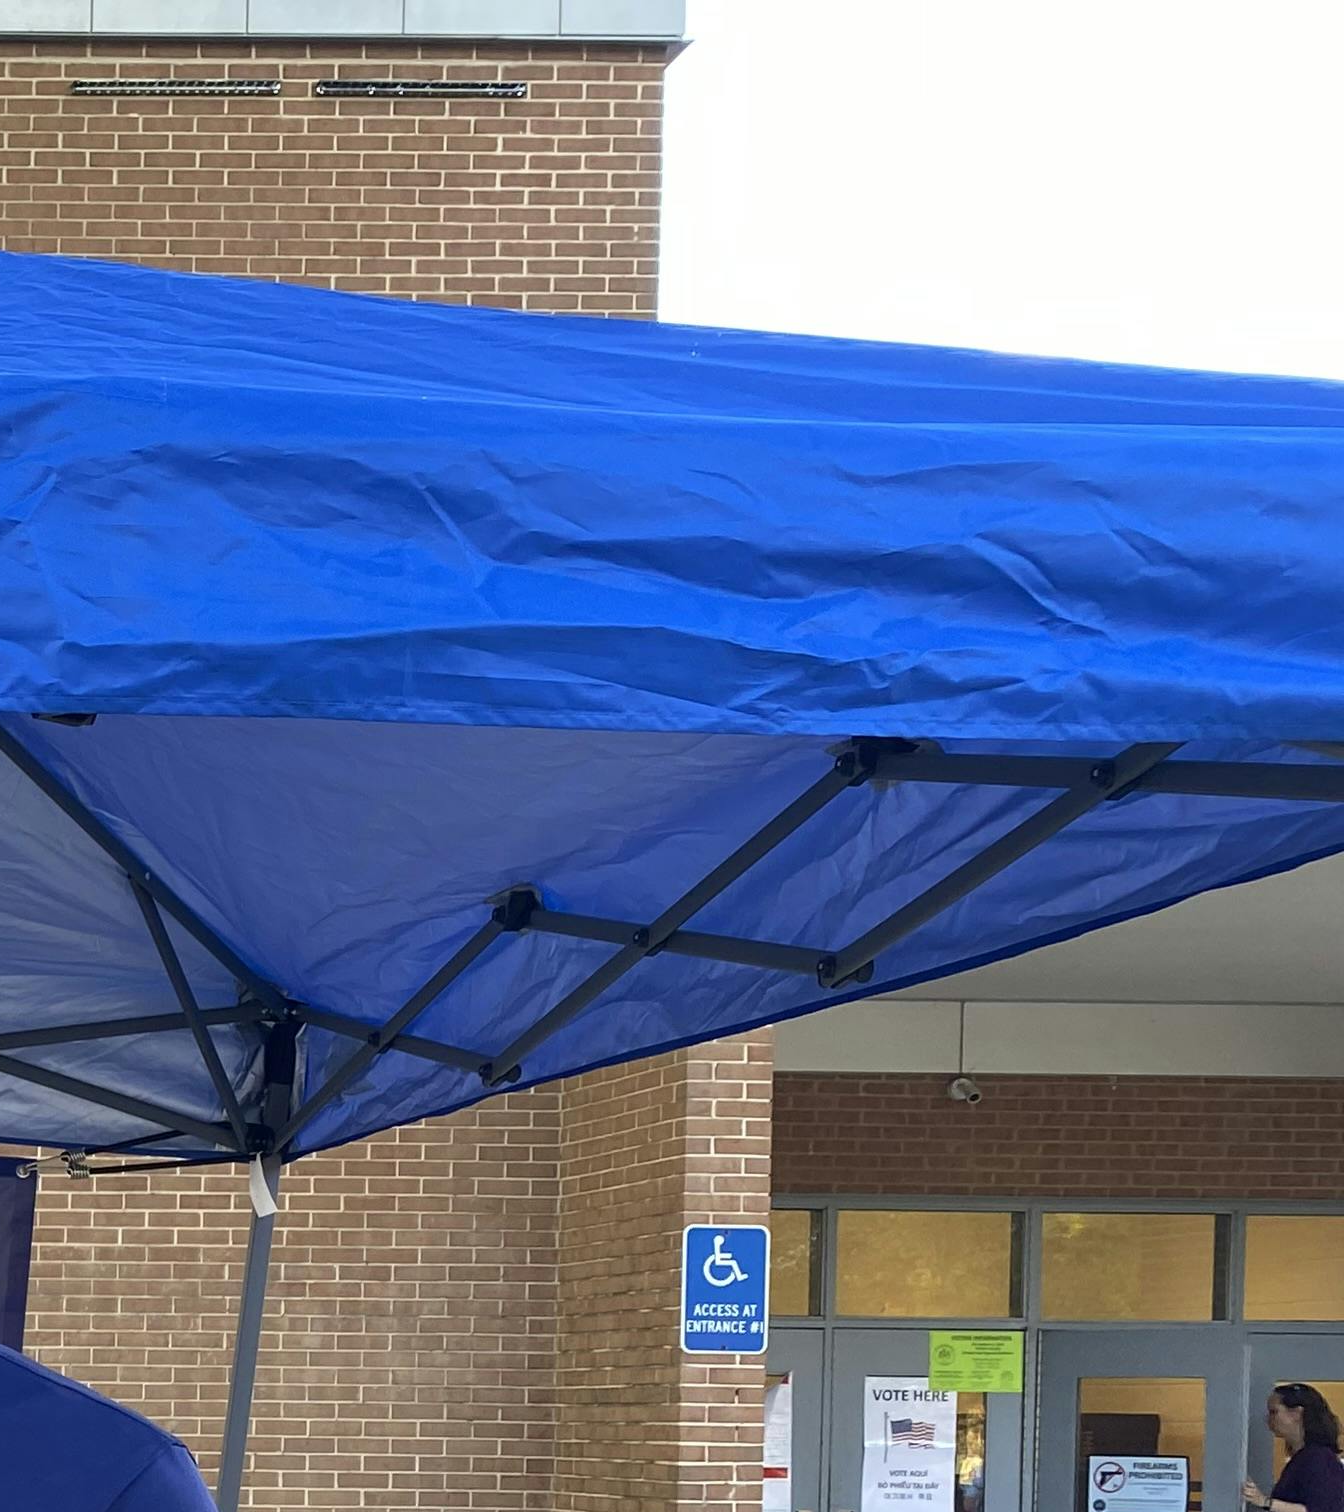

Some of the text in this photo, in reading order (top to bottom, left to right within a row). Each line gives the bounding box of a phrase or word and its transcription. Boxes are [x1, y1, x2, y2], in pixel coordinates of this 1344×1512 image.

[693, 1303, 757, 1317] ACCESS AT
[686, 1320, 764, 1334] ENTRANCE #1
[872, 1389, 949, 1402] VOTE HERE
